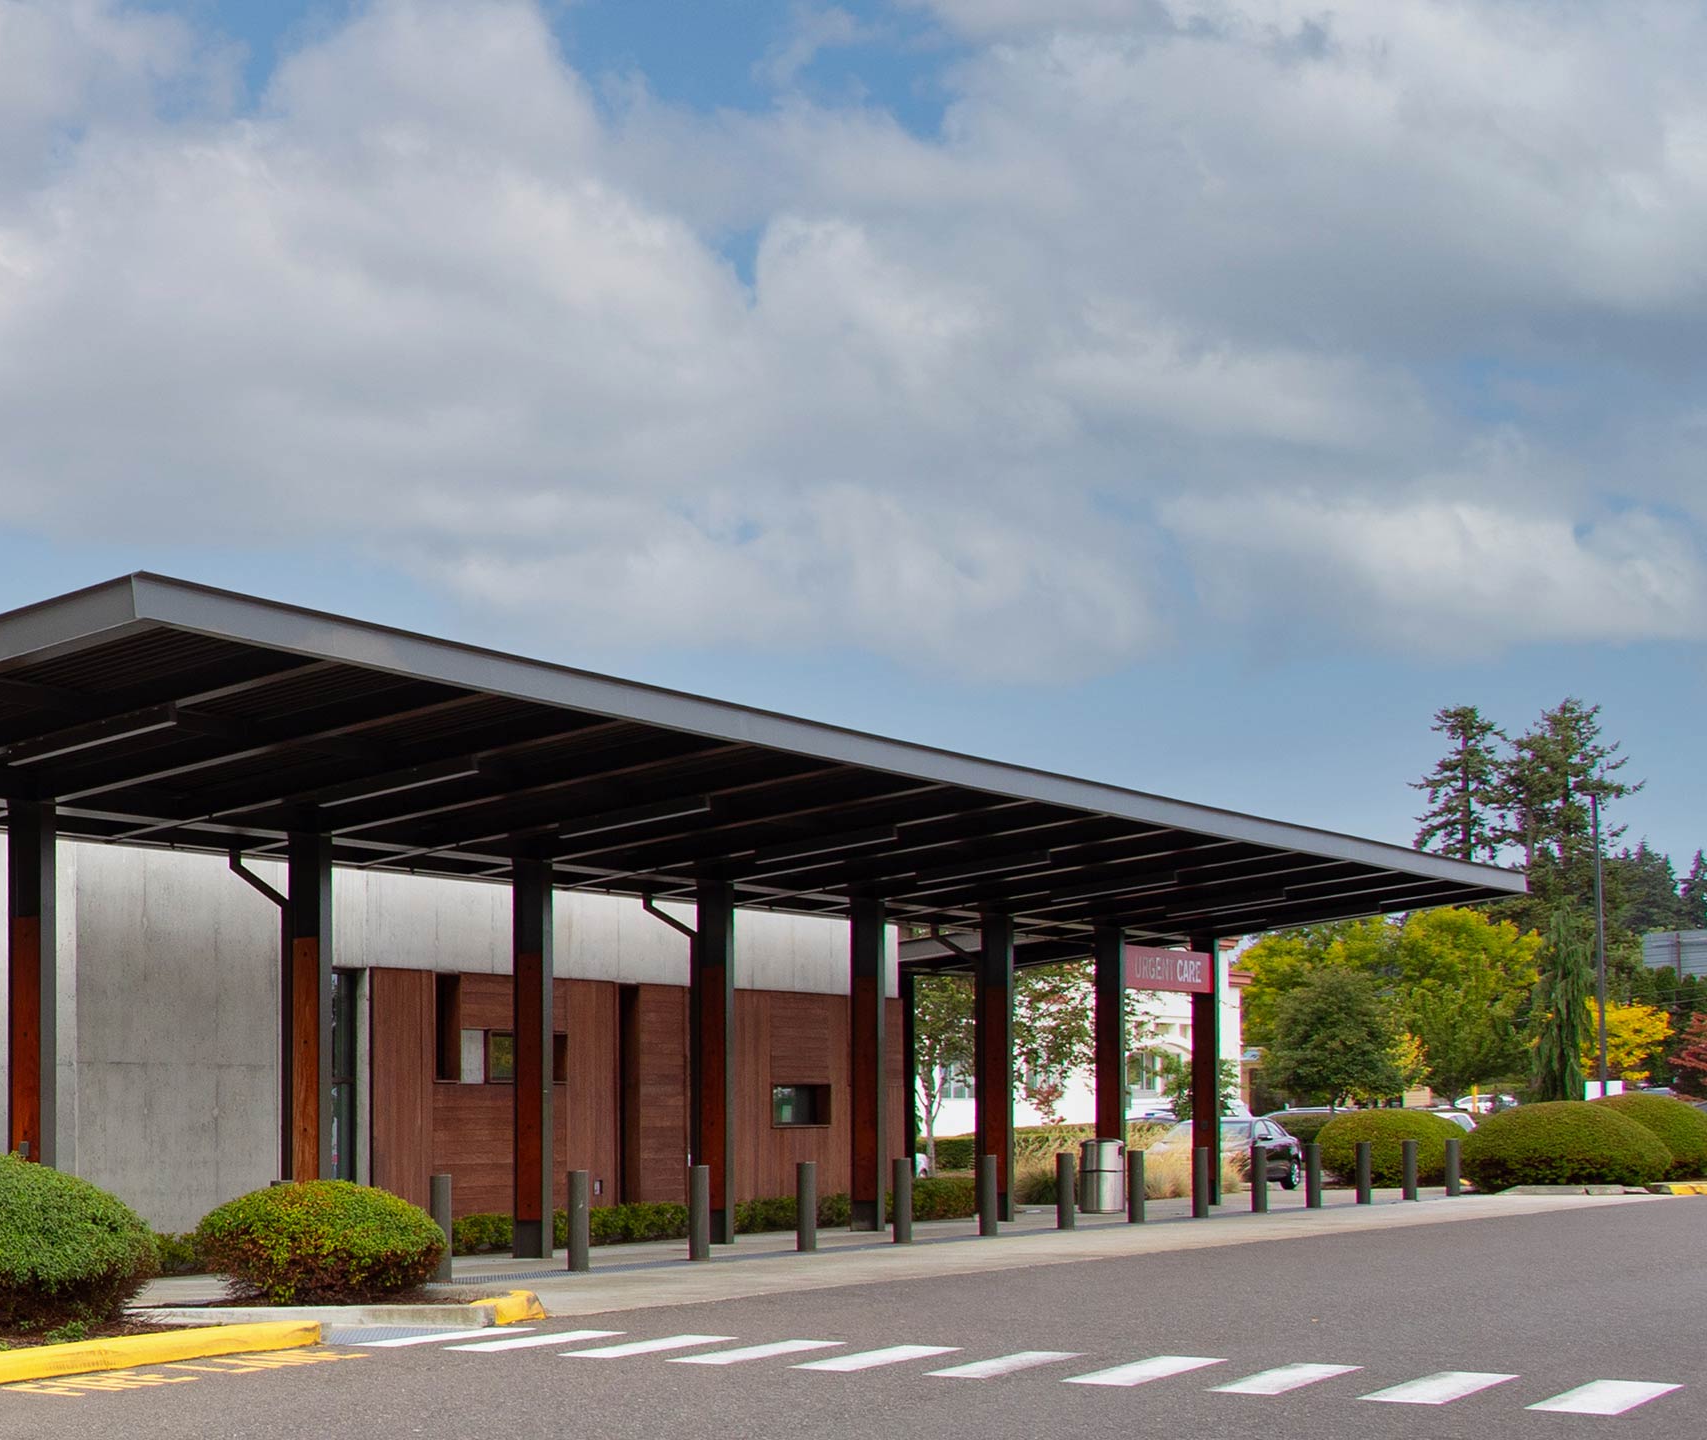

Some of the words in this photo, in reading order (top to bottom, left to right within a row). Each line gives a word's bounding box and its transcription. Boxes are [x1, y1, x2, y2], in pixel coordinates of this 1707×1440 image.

[1134, 956, 1174, 981] URGENT
[1175, 959, 1202, 983] CARE
[1, 1369, 200, 1397] FIRE
[163, 1349, 370, 1375] LANE
